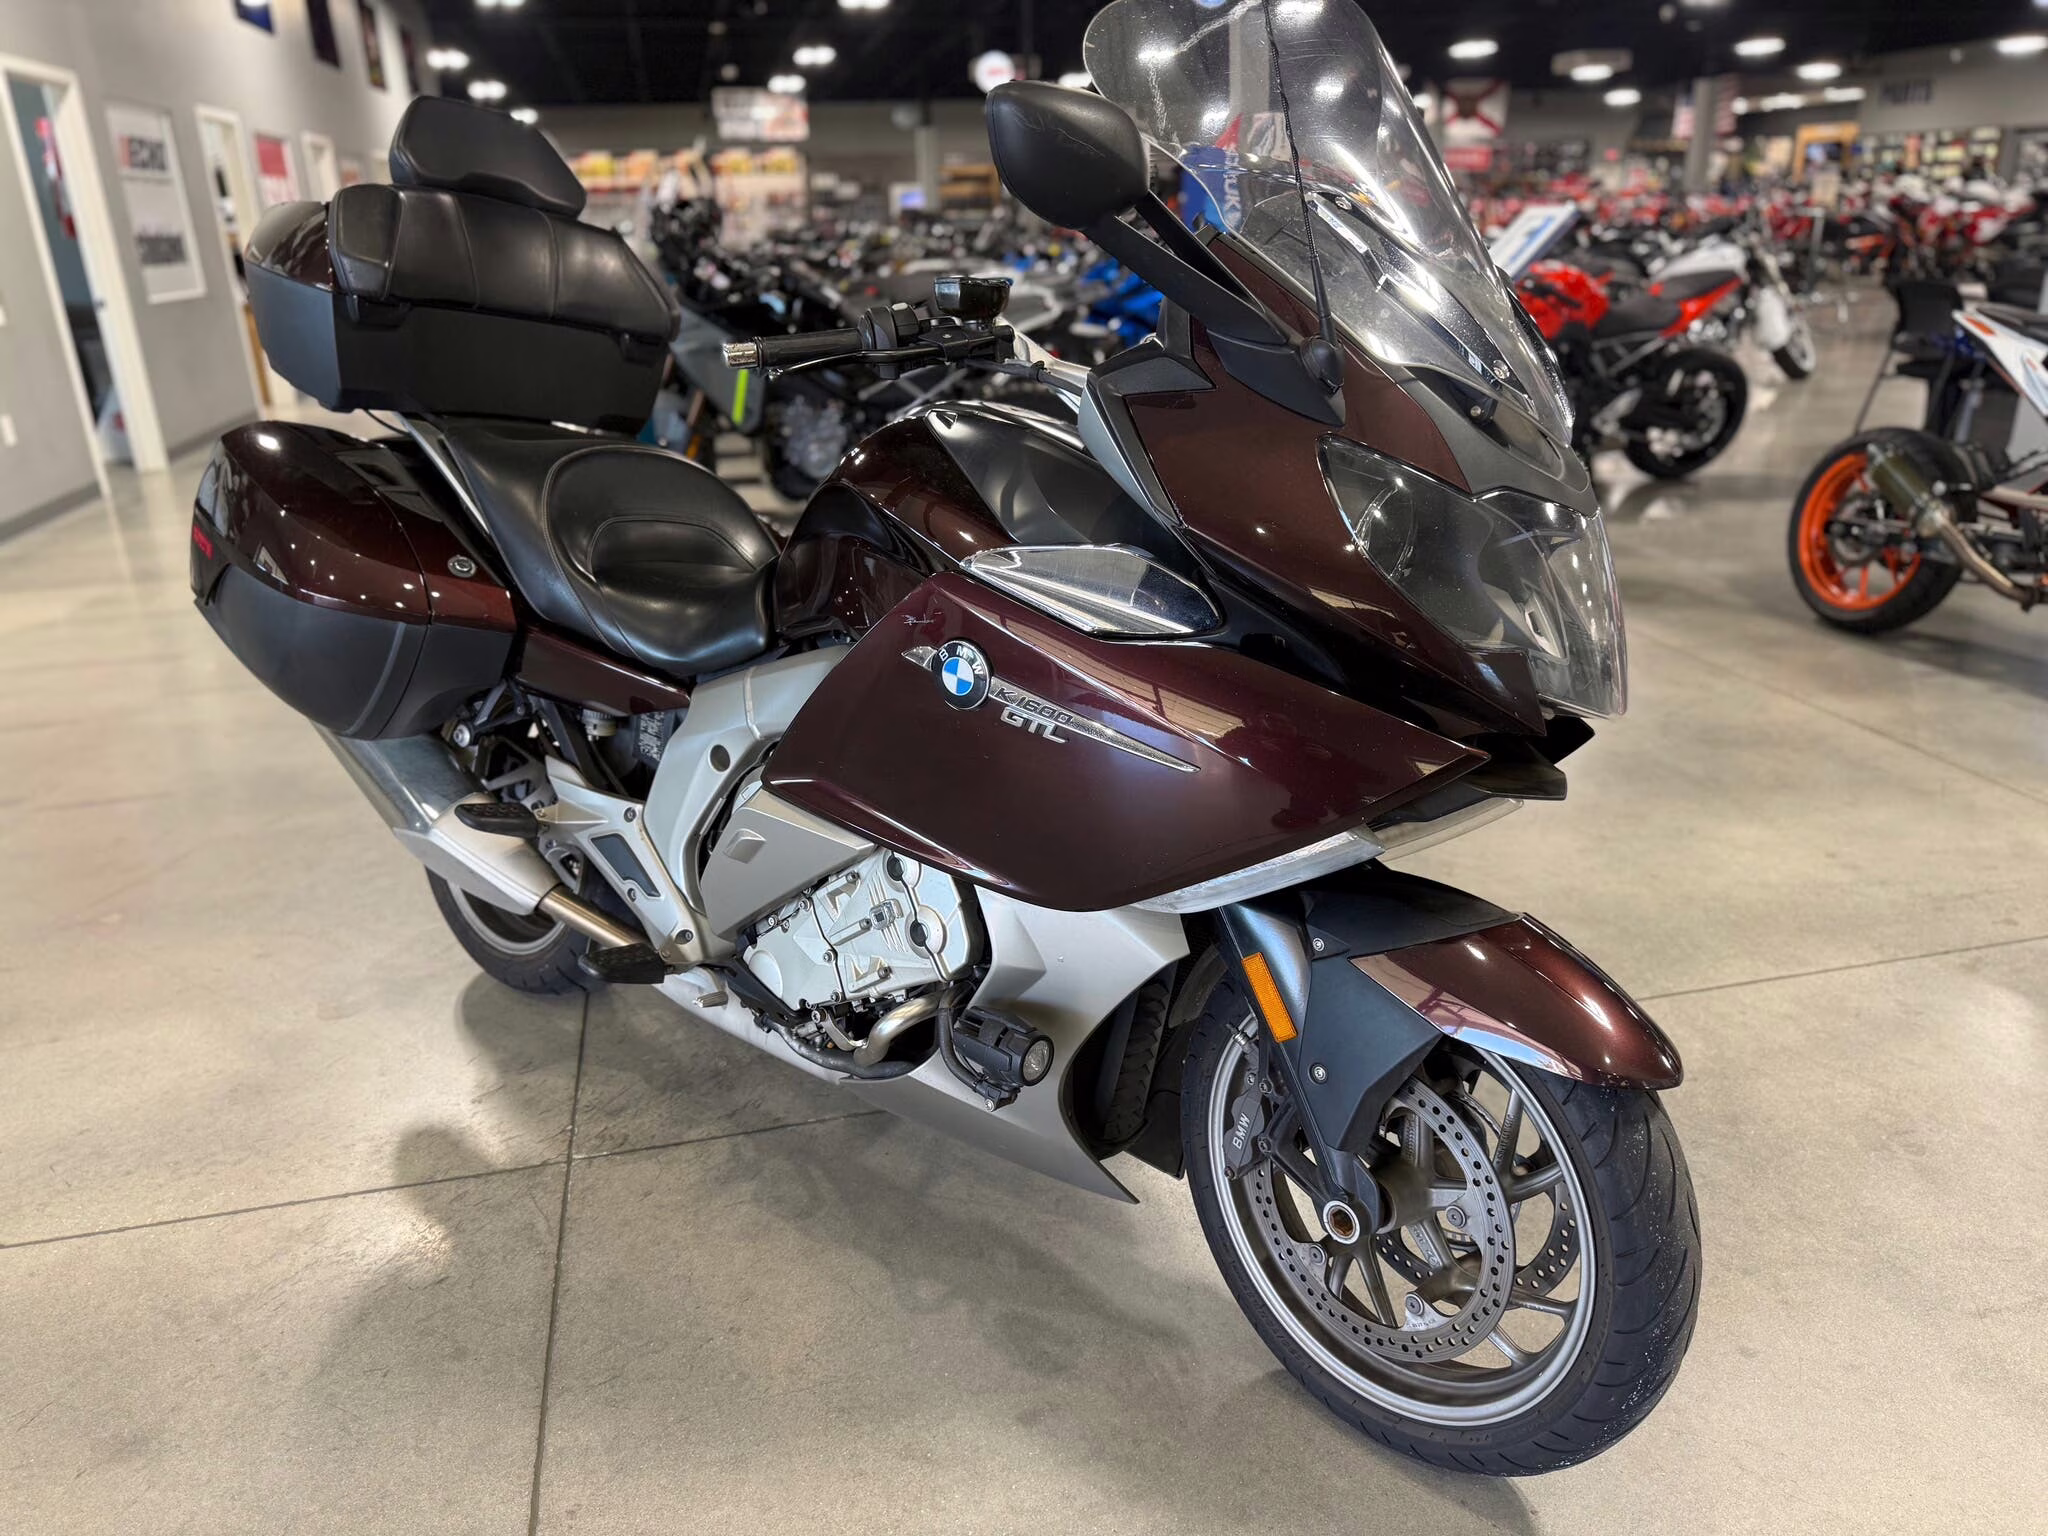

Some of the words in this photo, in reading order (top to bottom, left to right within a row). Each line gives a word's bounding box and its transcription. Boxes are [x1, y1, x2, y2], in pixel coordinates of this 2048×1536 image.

[939, 645, 984, 675] BMW
[1000, 706, 1067, 743] GTL
[1232, 1112, 1250, 1150] BMW
